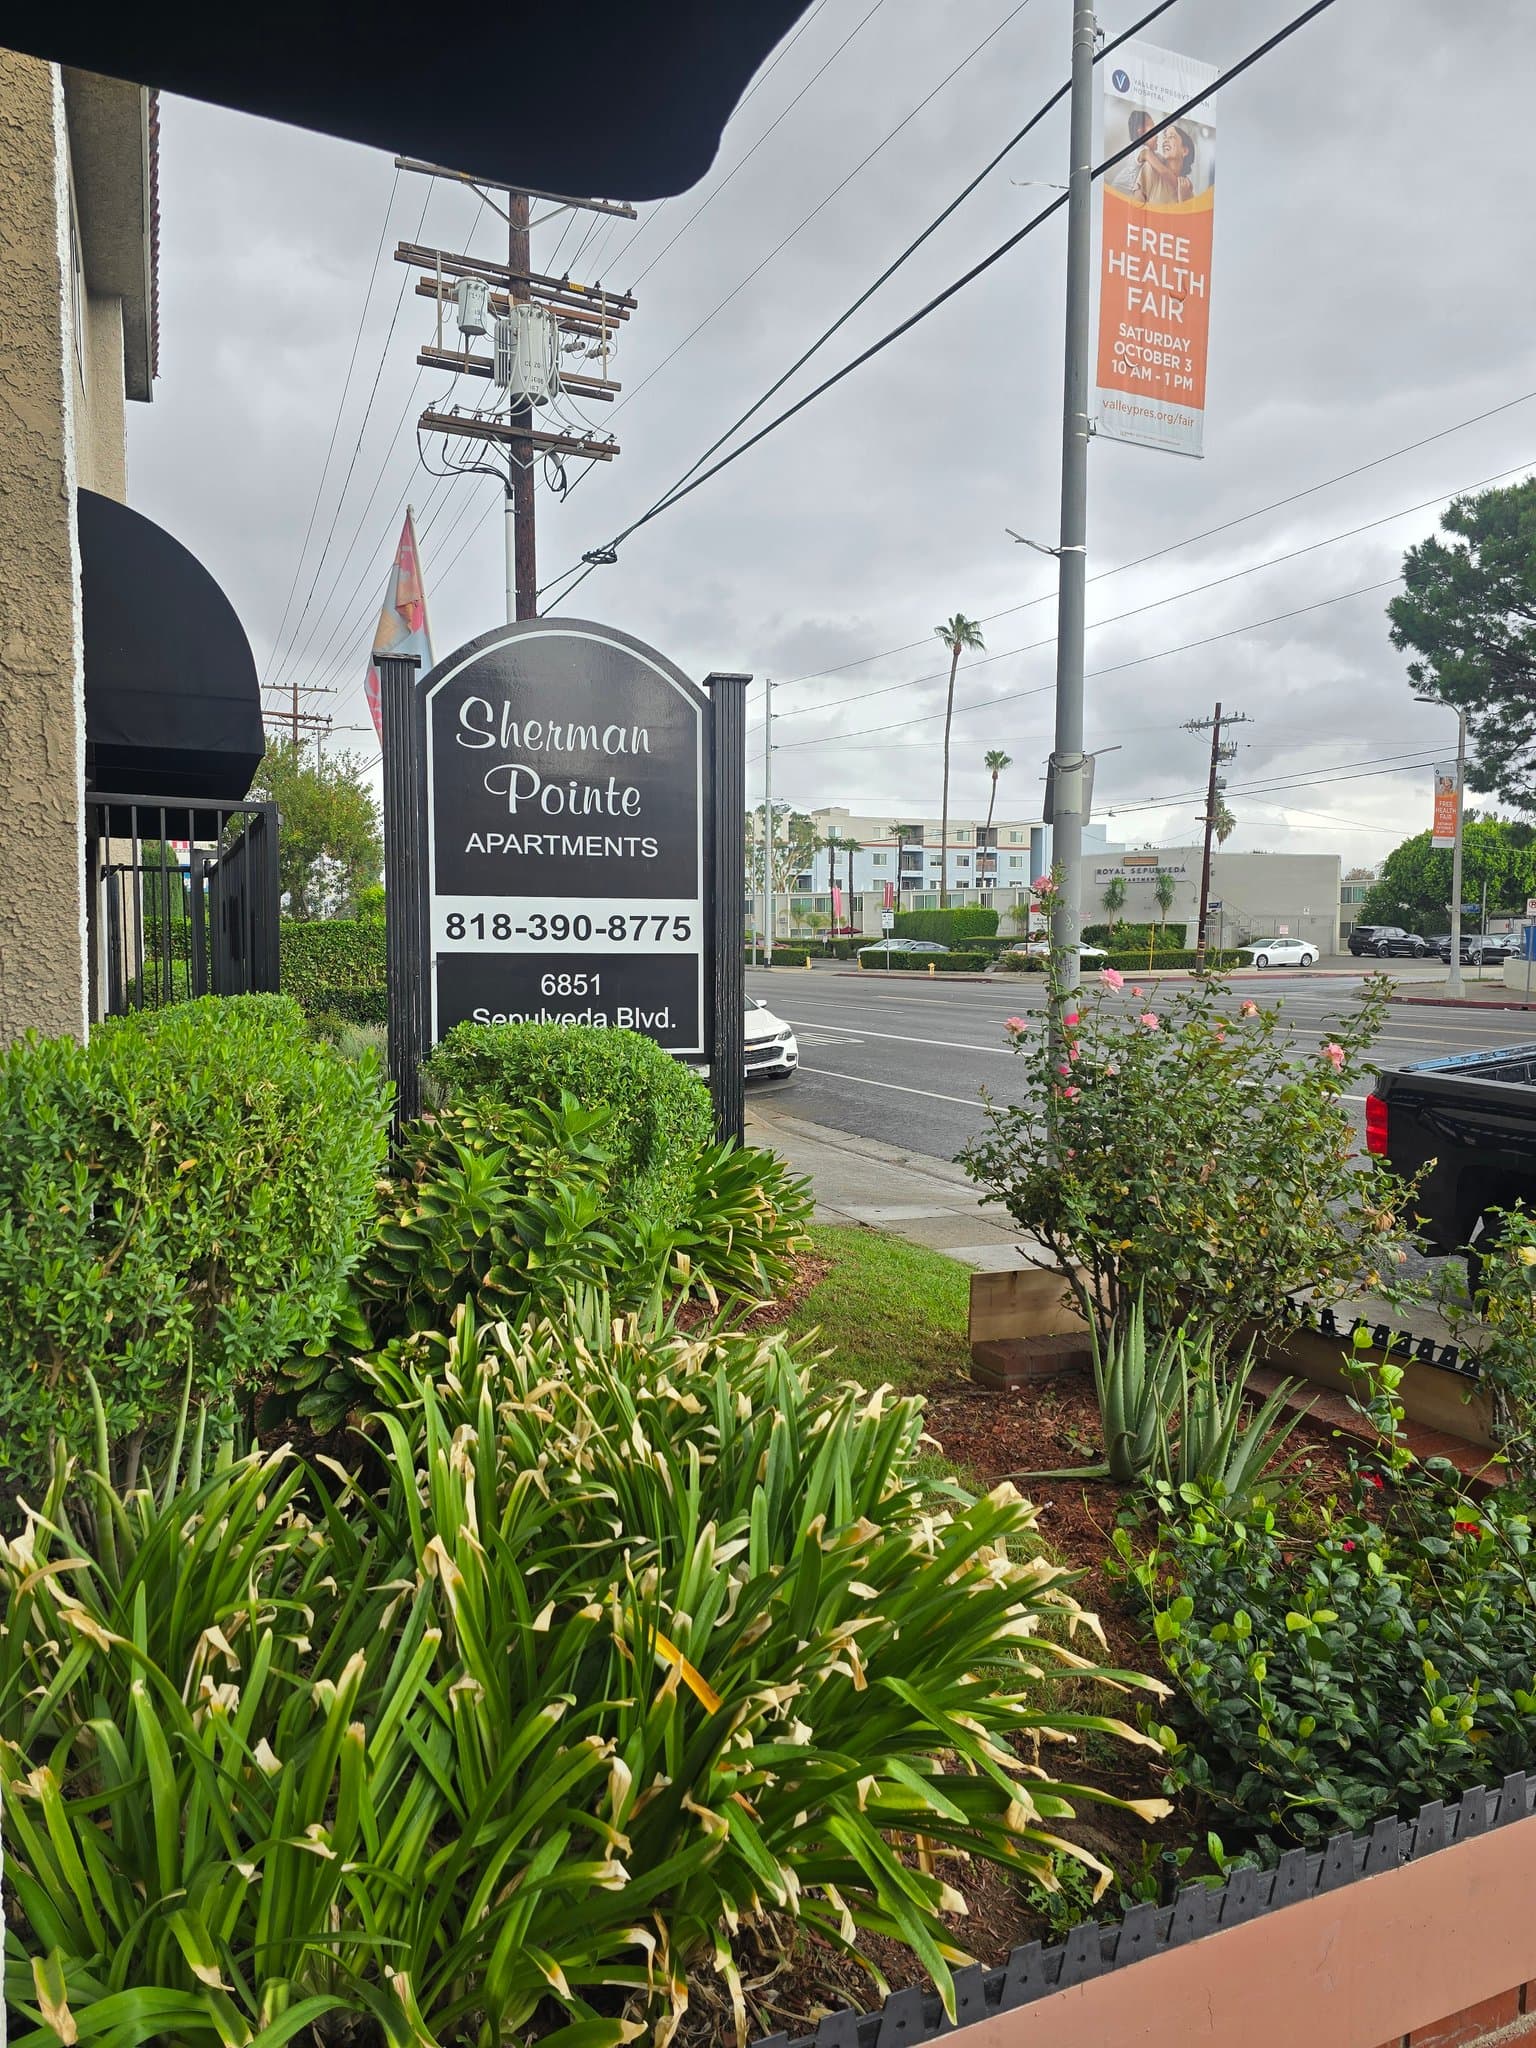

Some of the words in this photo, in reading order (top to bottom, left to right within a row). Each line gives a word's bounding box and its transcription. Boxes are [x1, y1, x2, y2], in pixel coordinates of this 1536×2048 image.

[1133, 80, 1158, 92] VALLEY
[1133, 87, 1166, 103] HOSPITAL
[1126, 223, 1191, 263] FREE
[1108, 249, 1205, 298] HEALTH
[1127, 286, 1185, 323] FAIR
[1119, 322, 1191, 353] SATURDAY
[1113, 341, 1180, 370] OCTOBER
[1184, 358, 1193, 373] 3
[1111, 359, 1127, 375] 10
[1130, 364, 1153, 382] AM
[1164, 372, 1170, 386] 1
[1173, 374, 1194, 392] PM
[1102, 398, 1195, 428] valleypres.org/fair
[456, 696, 651, 755] Sherman
[484, 763, 642, 817] Pointe
[465, 832, 659, 858] APARTMENTS
[445, 912, 692, 942] 818-390-8775
[540, 973, 601, 996] 6851
[617, 1006, 677, 1029] Blvd.
